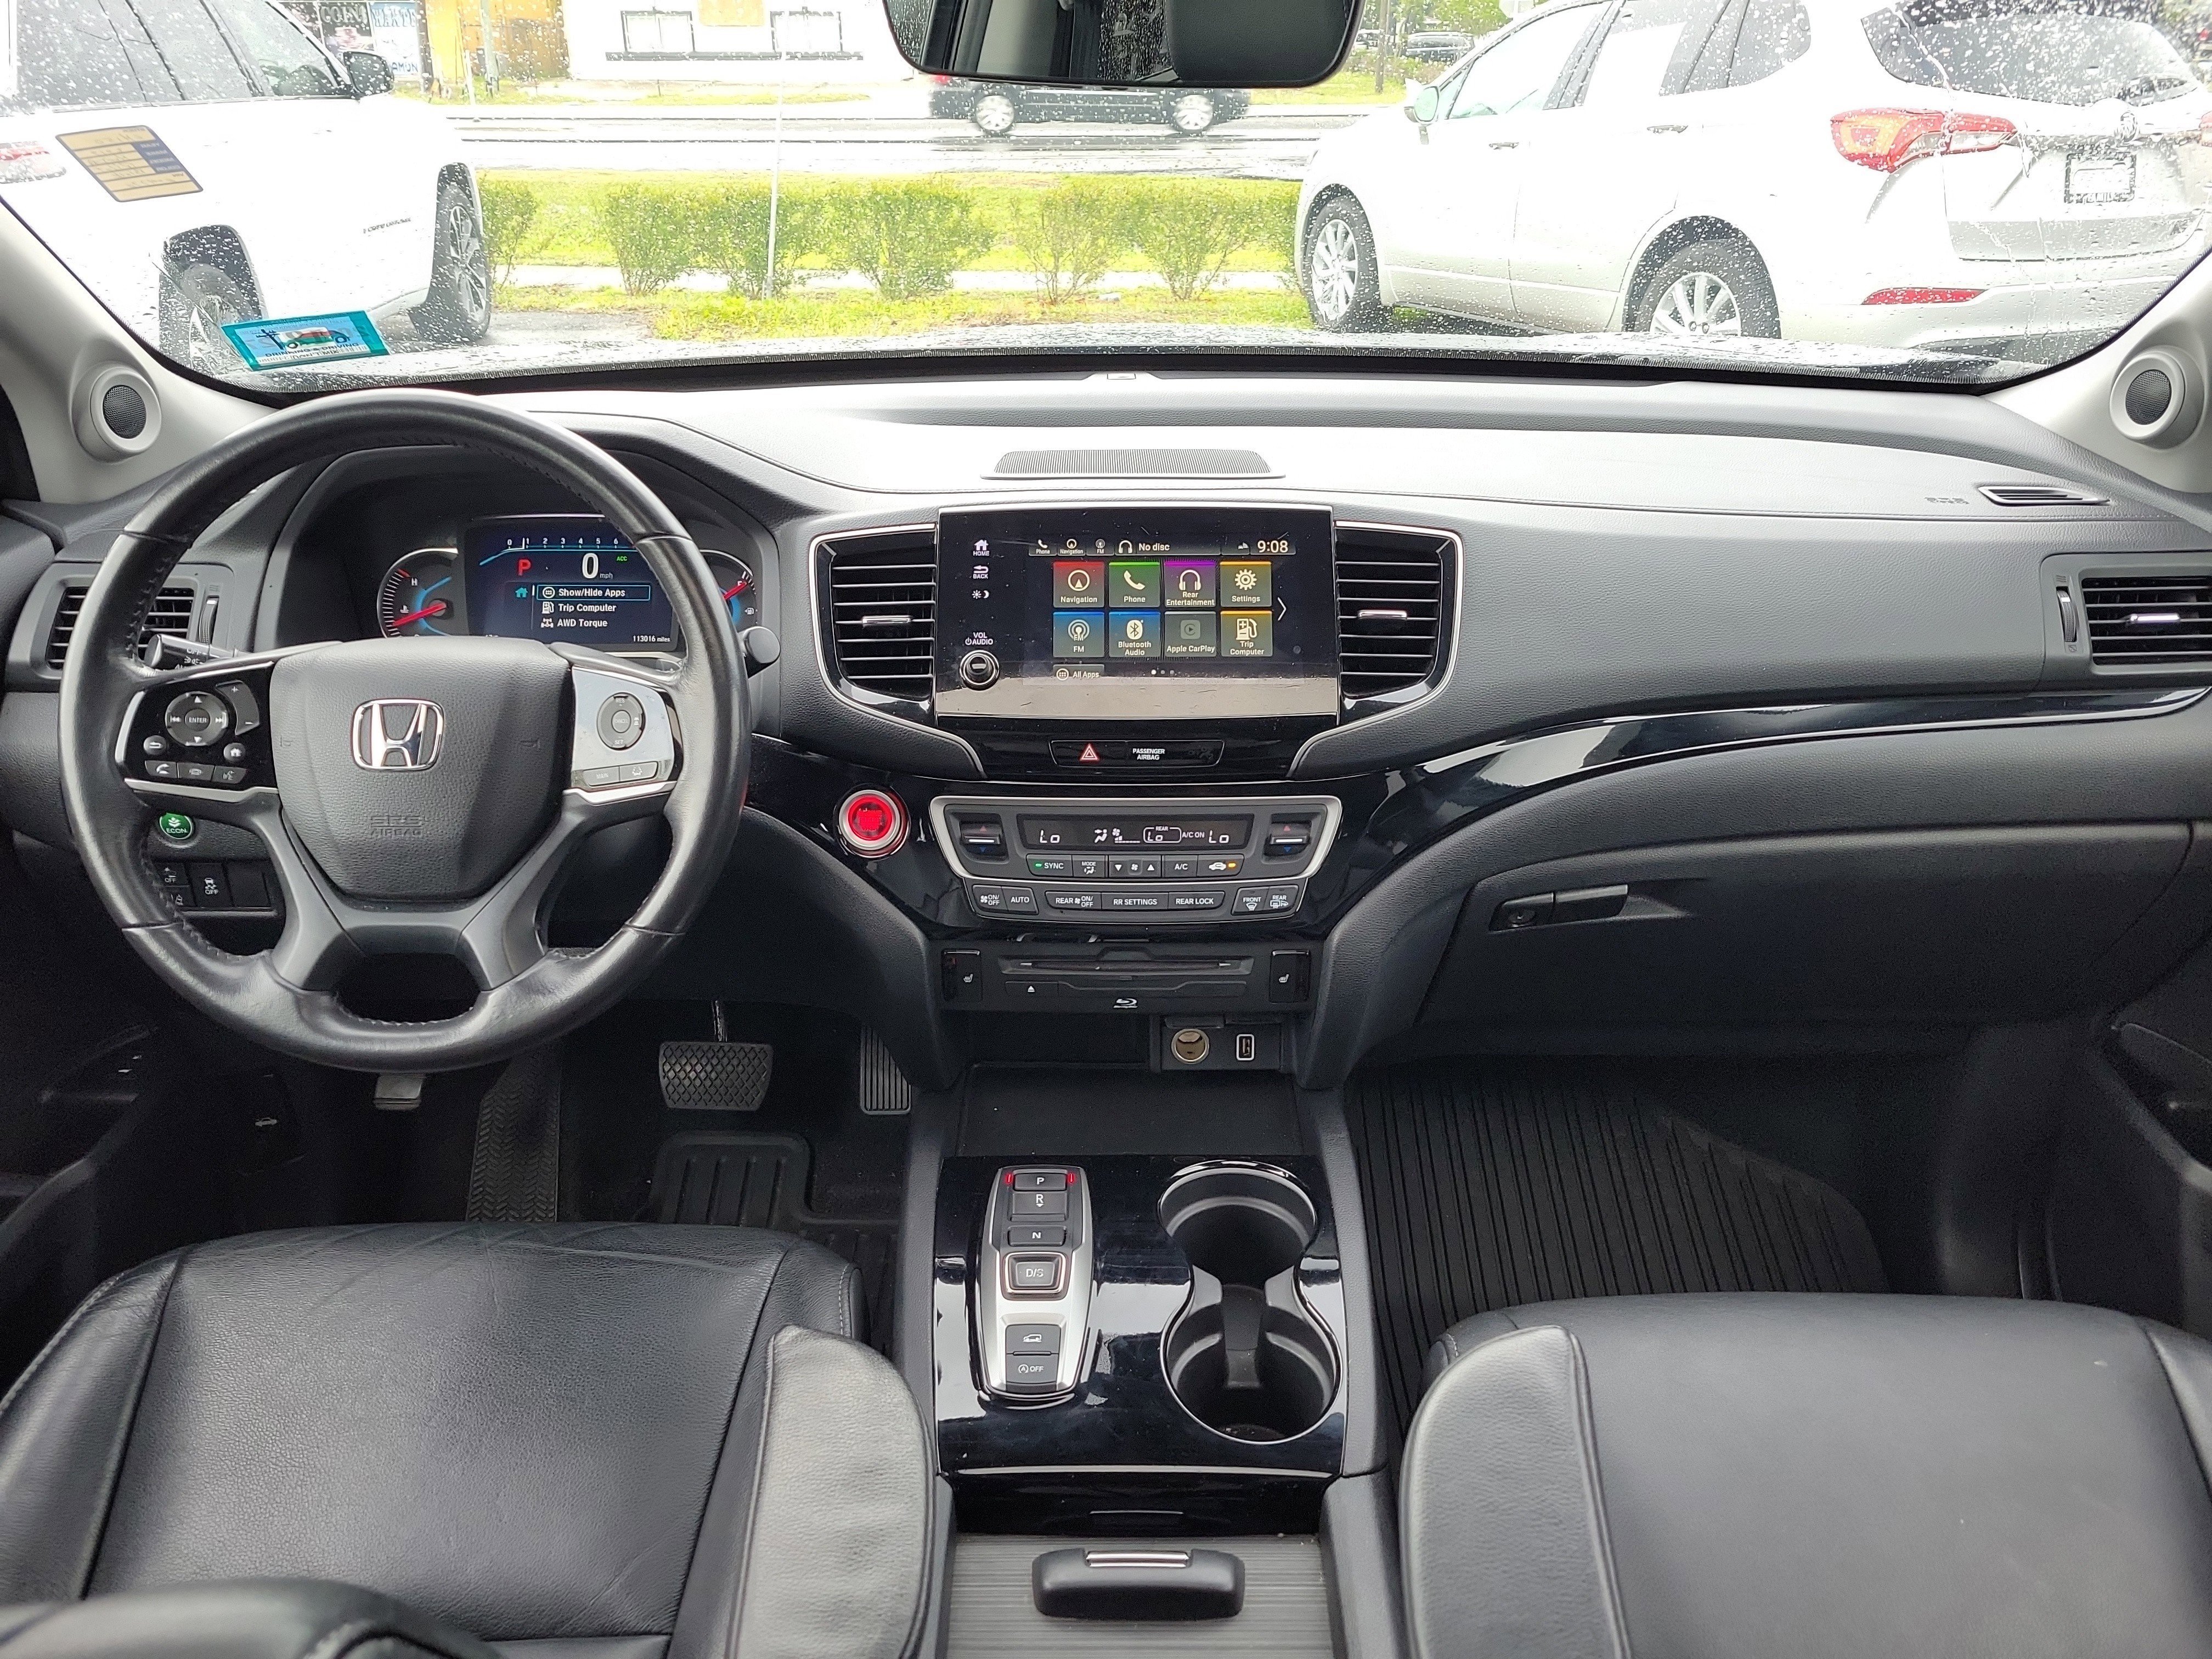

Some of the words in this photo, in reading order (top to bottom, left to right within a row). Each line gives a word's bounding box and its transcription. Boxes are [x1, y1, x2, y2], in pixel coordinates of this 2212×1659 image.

[321, 342, 359, 351] DRIVING
[1153, 543, 1170, 551] disc
[1257, 540, 1289, 553] 9:08
[518, 559, 531, 576] P
[582, 553, 599, 579] 0
[411, 578, 417, 586] H
[558, 588, 603, 597] Show/Hide
[604, 588, 625, 598] Apps
[1060, 596, 1098, 604] Navigation
[558, 603, 574, 613] Trip
[576, 603, 617, 613] Computer
[557, 619, 577, 627] AWD
[579, 619, 608, 628] Torque
[1166, 645, 1187, 653] Apple
[1188, 645, 1215, 653] CarPlay
[1083, 671, 1099, 679] Apps
[1036, 1177, 1045, 1185] P
[1036, 1194, 1044, 1204] R
[1025, 1268, 1044, 1278] D/S
